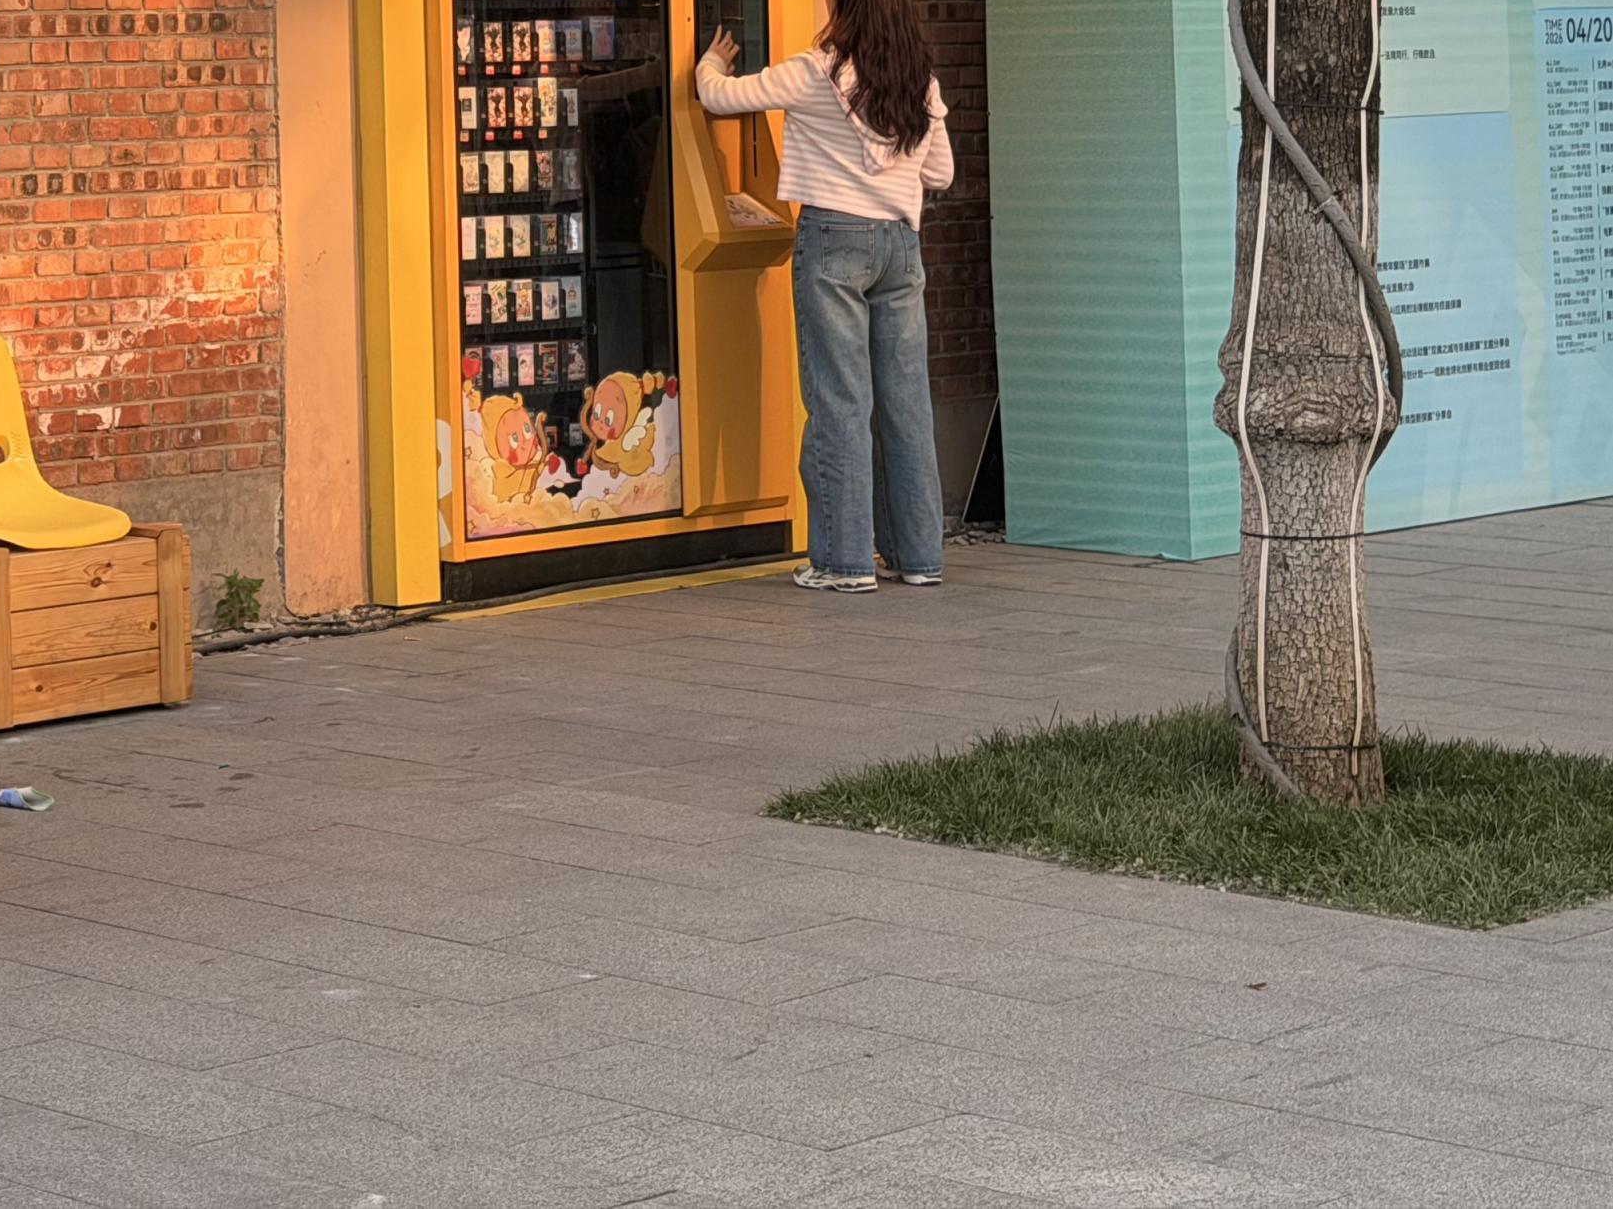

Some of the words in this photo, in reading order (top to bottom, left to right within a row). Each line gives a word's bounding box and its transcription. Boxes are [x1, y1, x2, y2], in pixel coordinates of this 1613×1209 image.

[1544, 18, 1563, 31] TIME
[1566, 17, 1613, 44] 04/20
[1545, 32, 1564, 45] 2026
